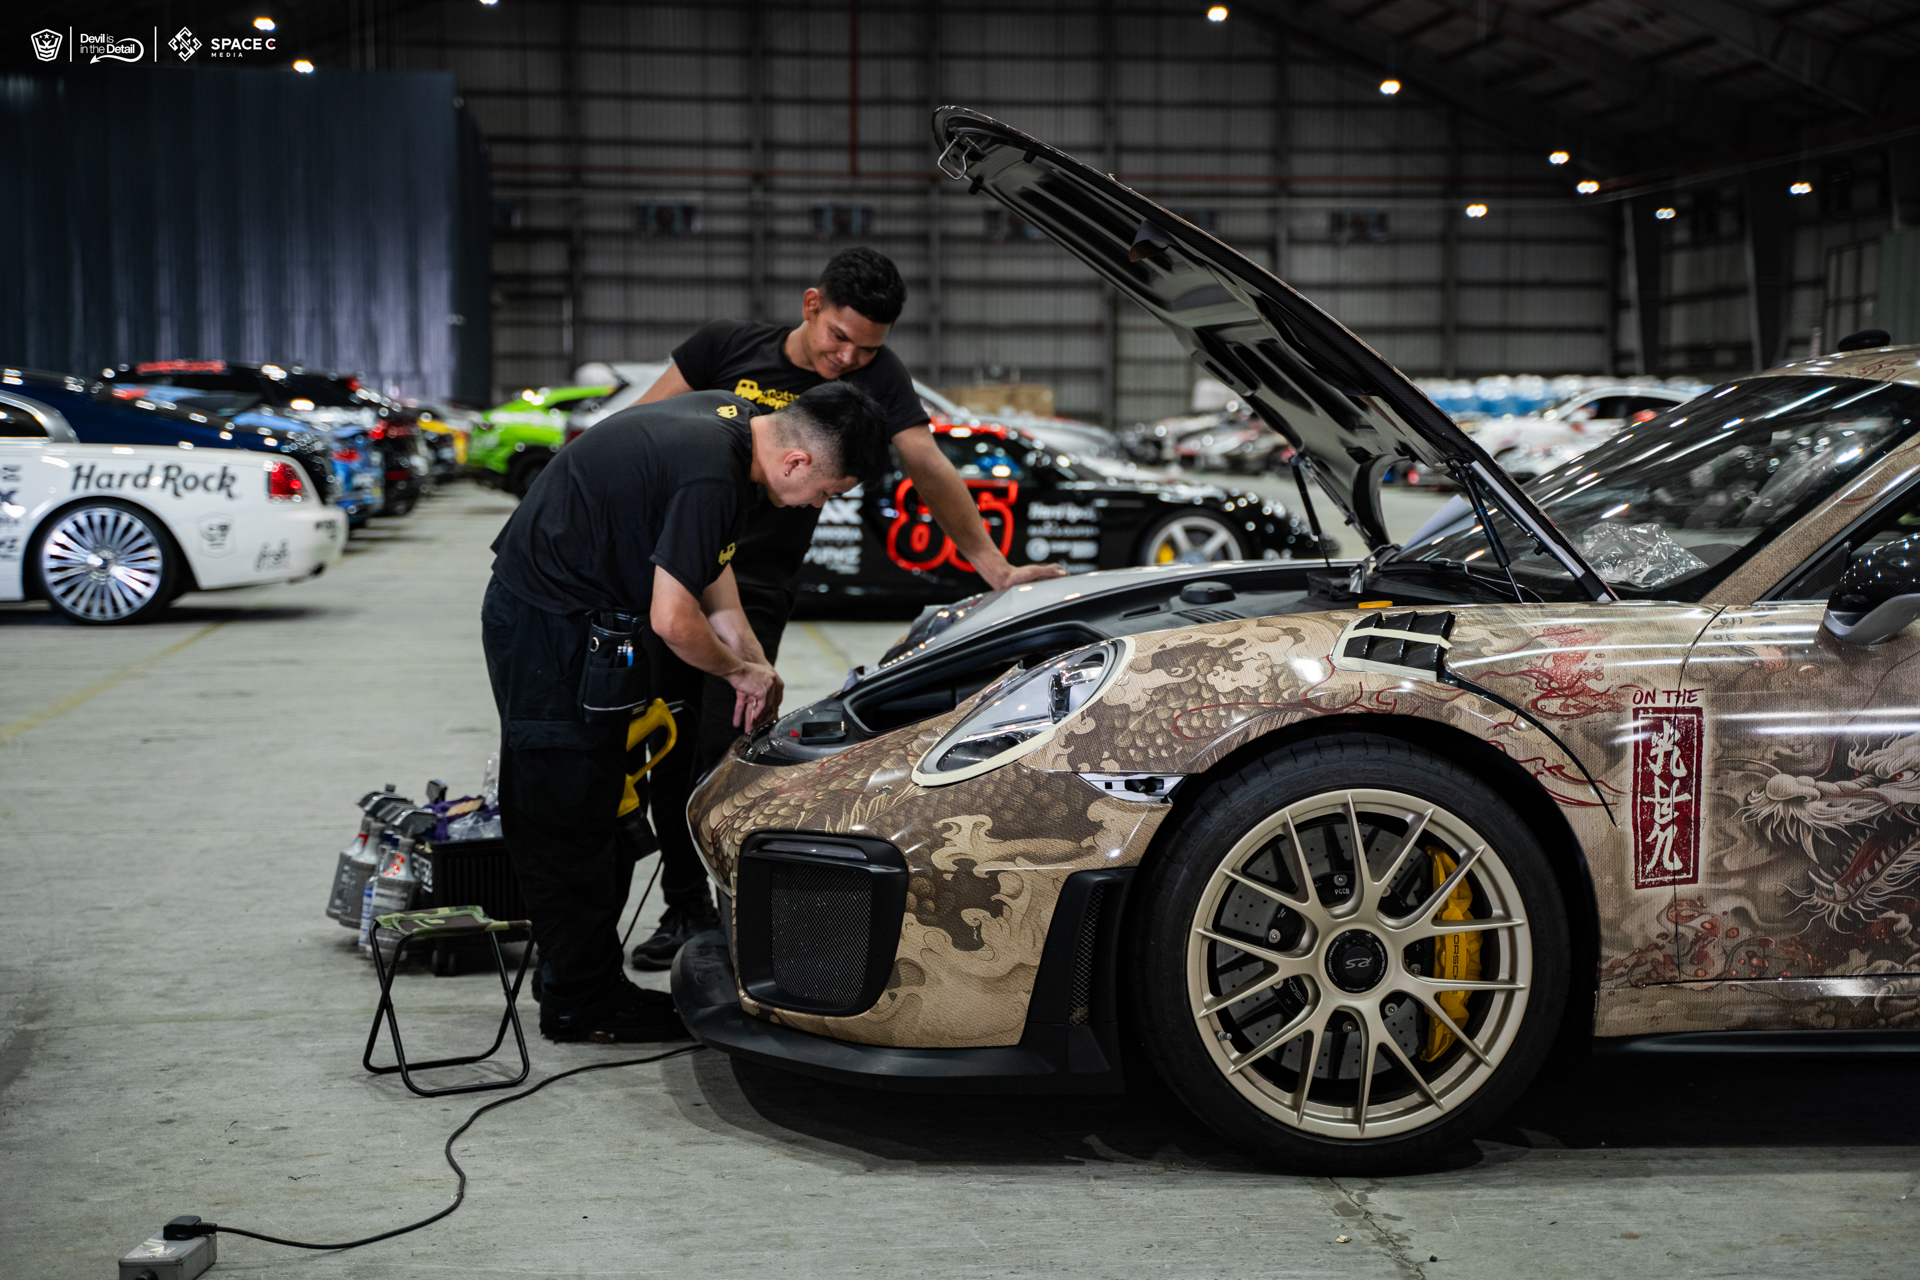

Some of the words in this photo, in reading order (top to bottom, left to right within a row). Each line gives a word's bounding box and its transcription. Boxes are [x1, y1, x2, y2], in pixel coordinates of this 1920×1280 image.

[71, 464, 154, 491] Hard
[160, 463, 237, 499] Rock
[1632, 689, 1656, 705] ON
[1662, 688, 1704, 705] THE
[1345, 957, 1373, 969] RS
[1452, 933, 1460, 994] ORSC
